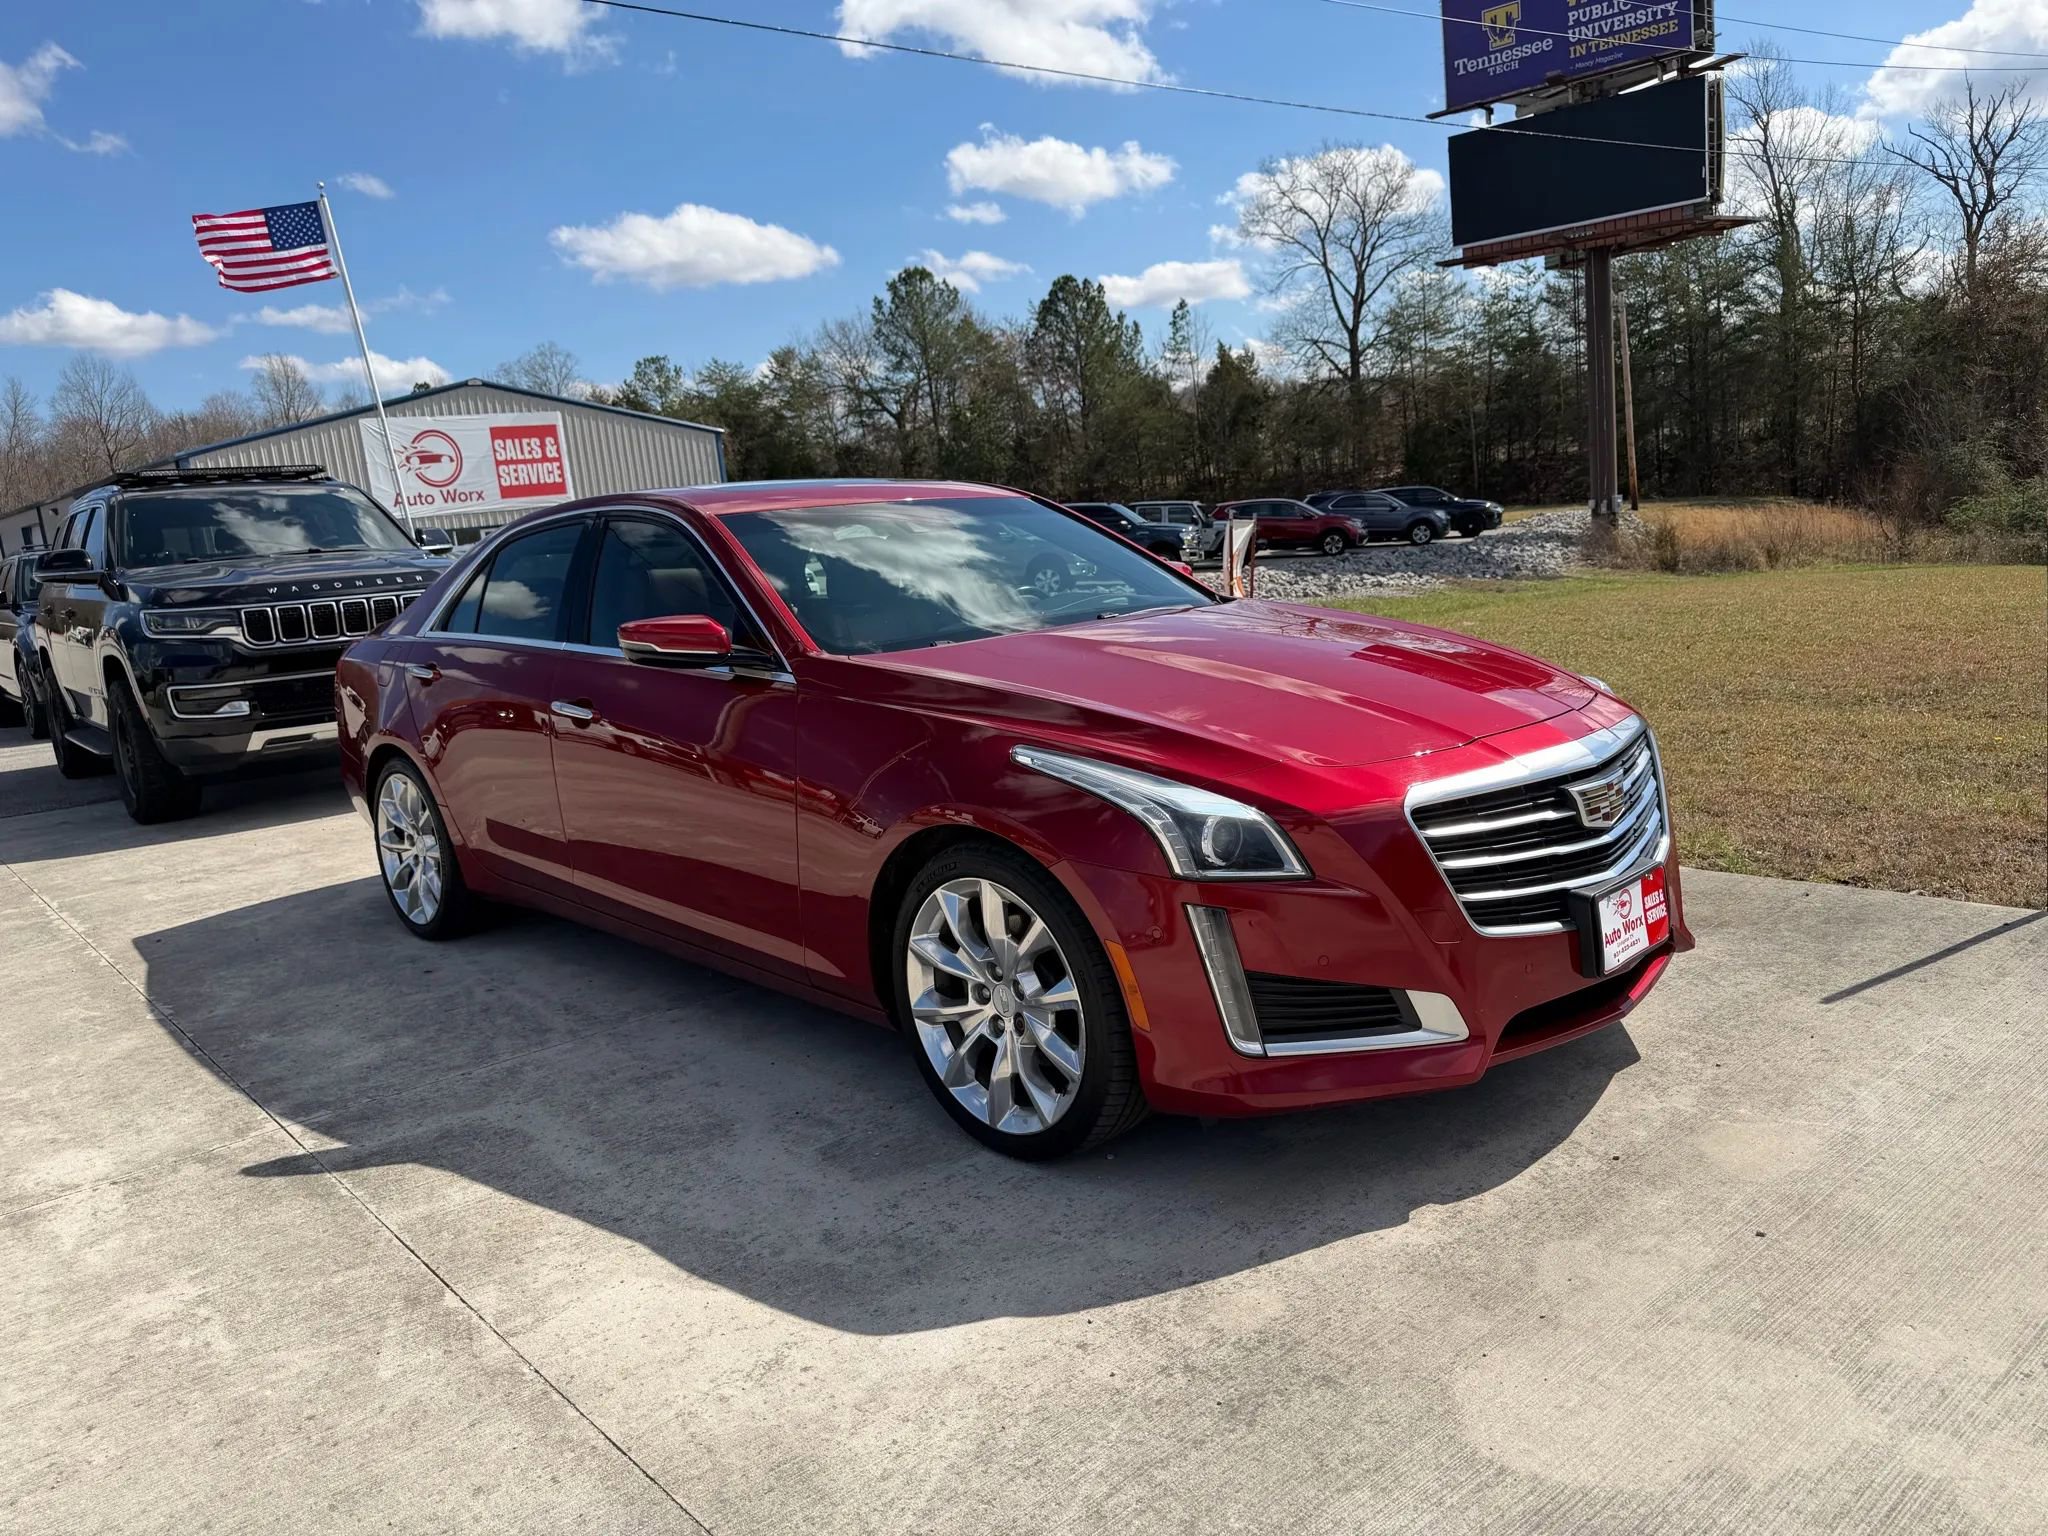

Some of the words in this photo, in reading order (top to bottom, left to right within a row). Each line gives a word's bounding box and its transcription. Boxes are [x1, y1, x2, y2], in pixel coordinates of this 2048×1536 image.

[1568, 0, 1631, 25] PUBLIC
[1568, 1, 1678, 42] UNIVERSITY
[1569, 43, 1587, 58] IN
[1588, 19, 1678, 53] TENNESSEE
[1454, 38, 1553, 76] Tennessee
[1487, 60, 1519, 76] TECH
[494, 438, 541, 460] SALES
[544, 437, 559, 458] &
[500, 463, 563, 487] SERVICE
[394, 492, 435, 508] Auto
[440, 489, 485, 504] Worx
[267, 575, 423, 595] WAGONEER
[1644, 891, 1659, 909] SALES
[1646, 903, 1667, 924] SERVICE
[1604, 928, 1621, 948] Auto
[1622, 915, 1644, 935] Worx
